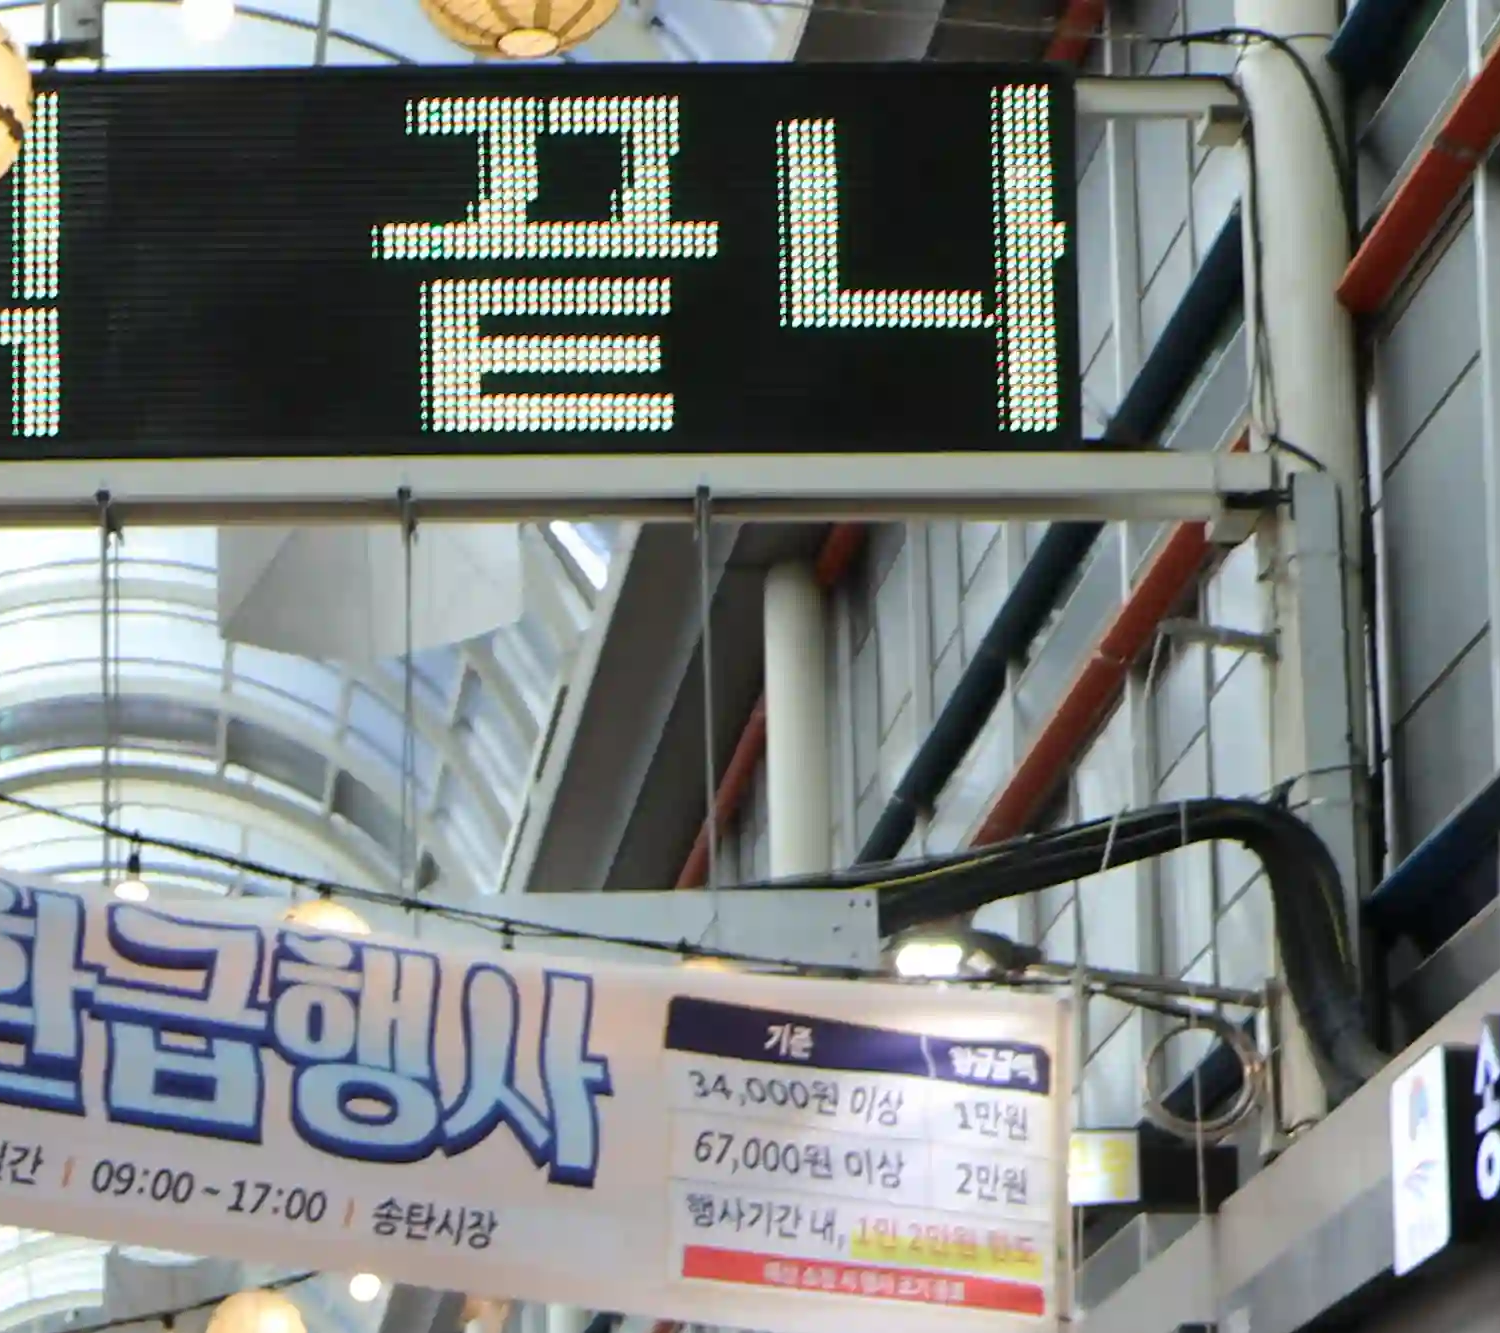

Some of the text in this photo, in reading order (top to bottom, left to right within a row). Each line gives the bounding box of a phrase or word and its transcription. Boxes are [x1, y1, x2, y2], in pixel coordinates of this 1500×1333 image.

[372, 84, 1067, 436] 끝나
[687, 1069, 1030, 1143] 34,000원 이상 1만원
[693, 1130, 834, 1181] 67,000원
[844, 1148, 906, 1190] 이상
[955, 1161, 1030, 1205] 2만원
[370, 1196, 499, 1250] 송탄시장
[685, 1192, 802, 1241] 행사기간
